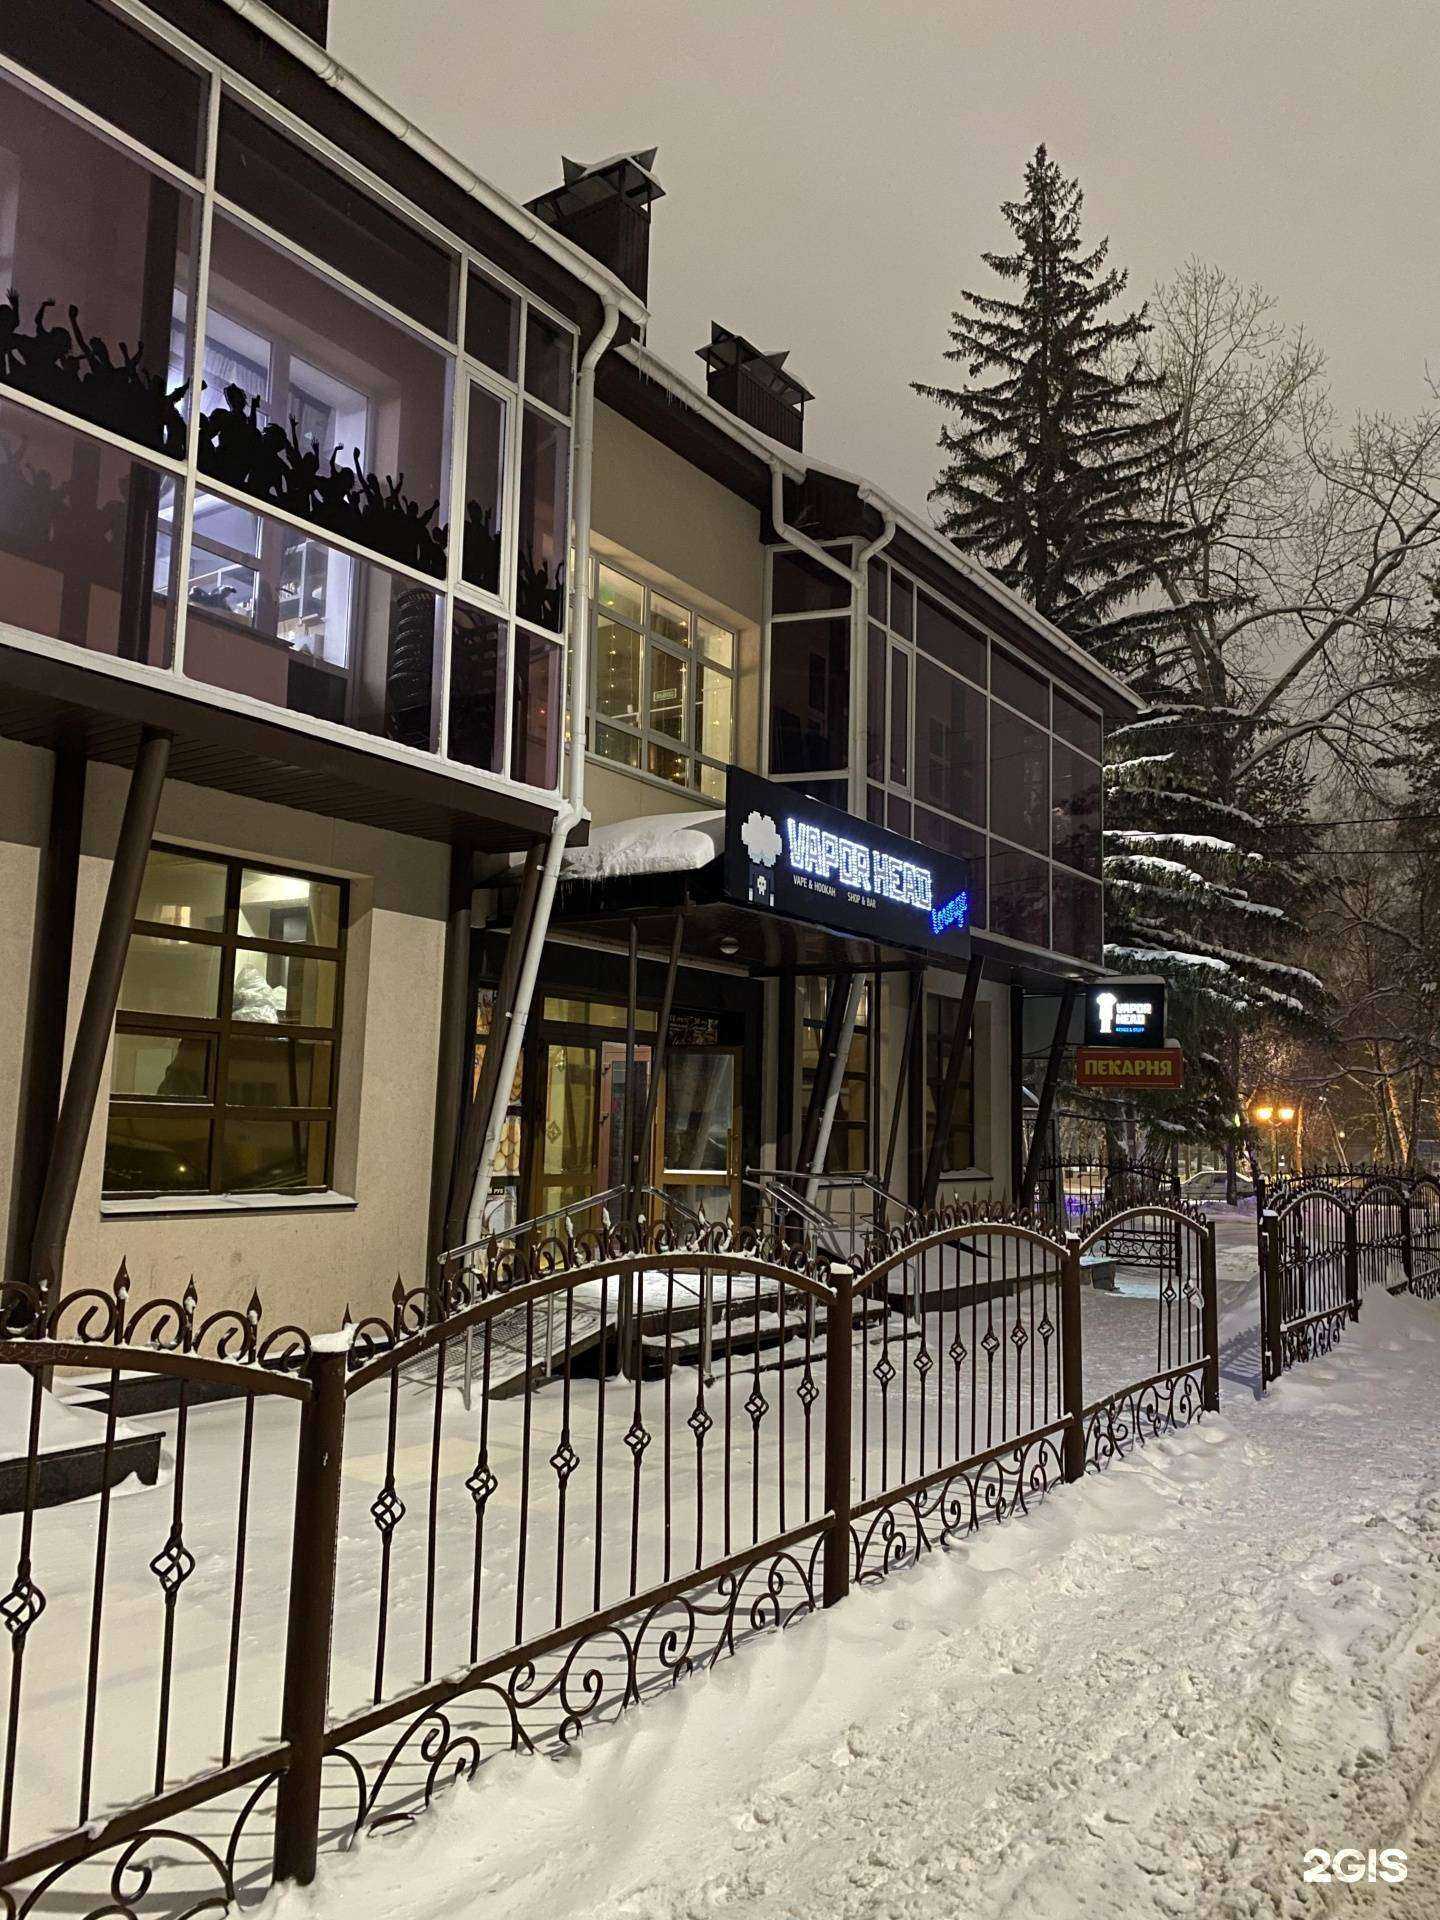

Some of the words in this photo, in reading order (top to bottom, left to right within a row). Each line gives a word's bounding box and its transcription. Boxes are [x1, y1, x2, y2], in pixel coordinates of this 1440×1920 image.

[787, 817, 872, 892] VAPOR
[872, 850, 932, 911] HEAD
[793, 874, 808, 888] VAPE
[808, 879, 813, 890] &
[814, 881, 836, 897] HOOKAH
[847, 891, 861, 904] SHOP
[861, 896, 866, 906] &
[866, 897, 877, 909] BAR
[1115, 1014, 1146, 1025] HEAD
[1084, 1060, 1173, 1076] ПЕКАРНЯ
